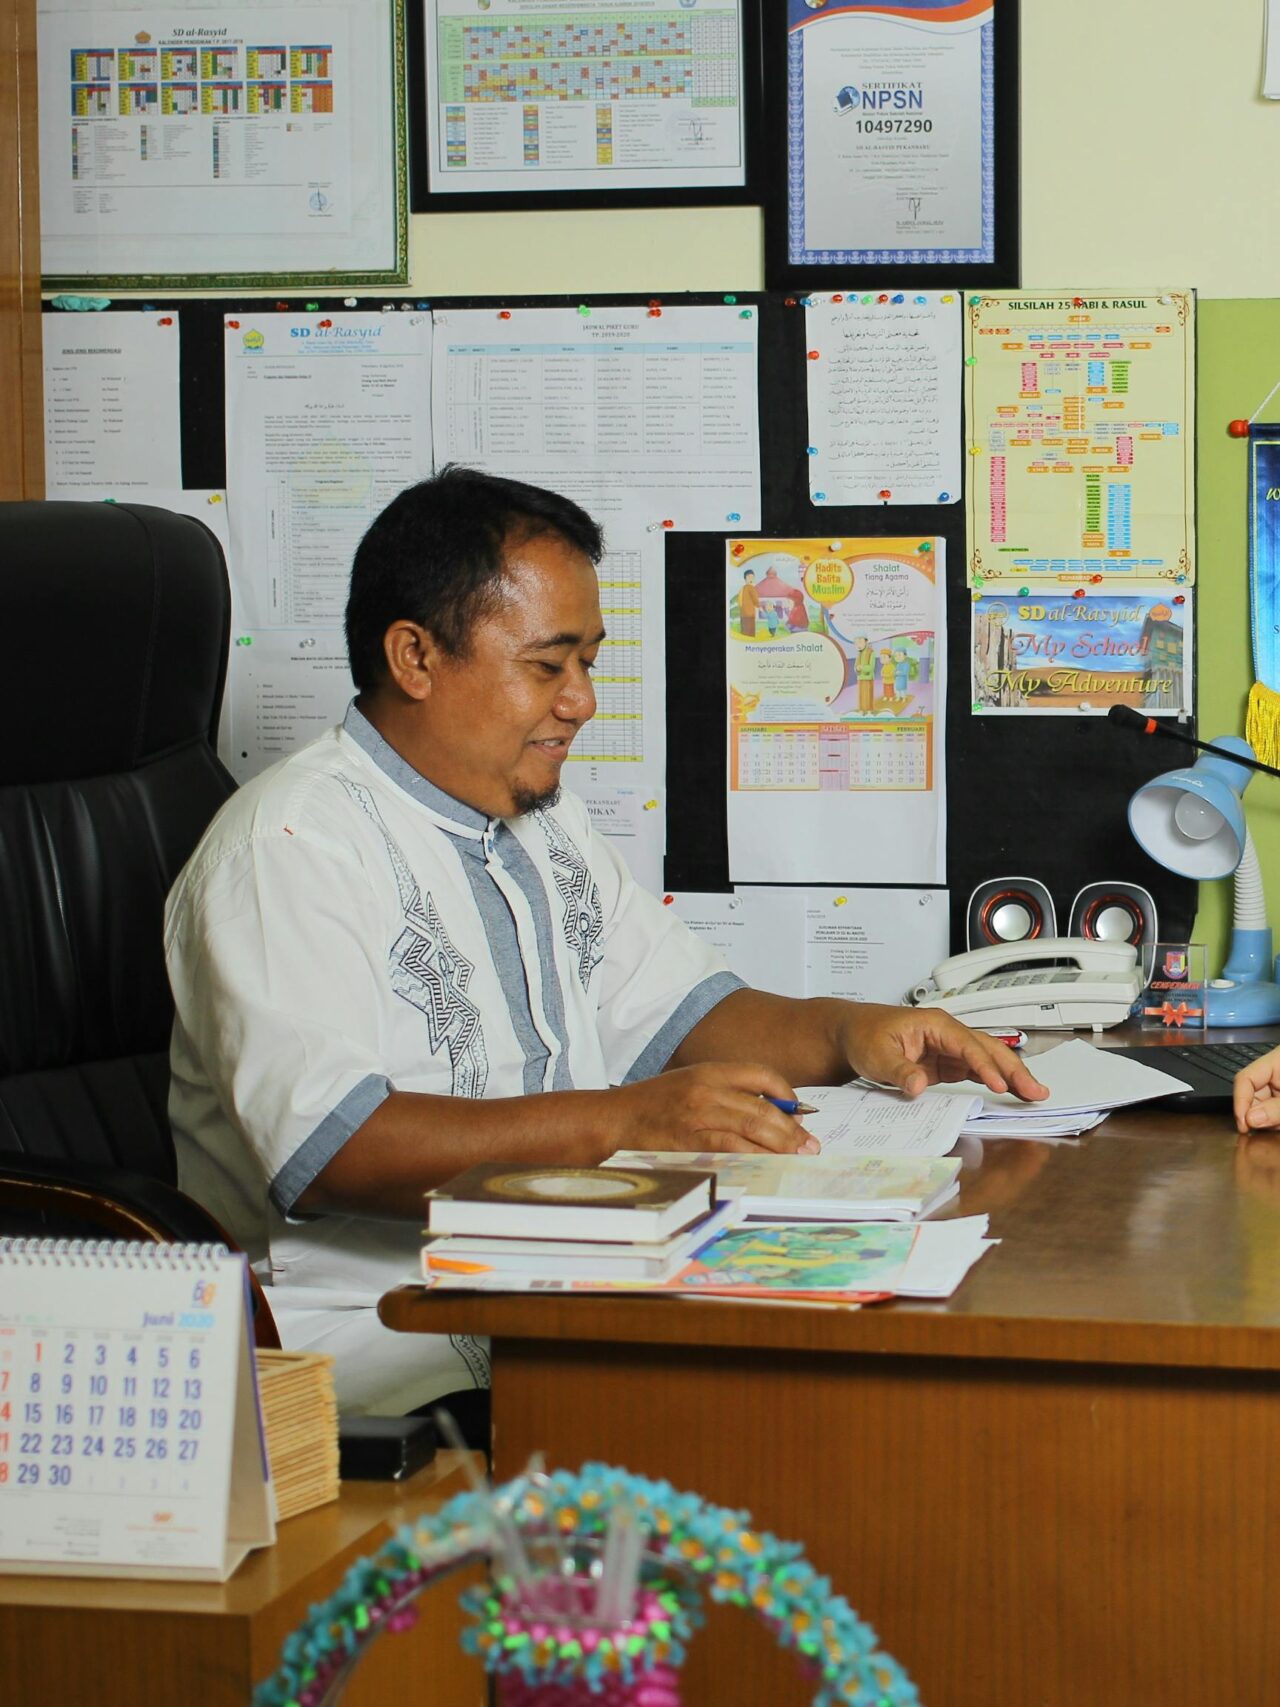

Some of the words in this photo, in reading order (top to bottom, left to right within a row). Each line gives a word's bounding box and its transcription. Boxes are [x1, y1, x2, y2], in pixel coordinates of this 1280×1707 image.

[862, 90, 923, 110] NPSN
[856, 120, 933, 134] 10497290
[1008, 300, 1054, 310] SILSILAH
[1058, 300, 1071, 310] 25
[1074, 300, 1099, 310] NABI
[1101, 300, 1110, 310] &
[1112, 299, 1148, 310] RASUL
[290, 328, 311, 338] SD
[314, 324, 384, 340] al-Rasyid
[815, 562, 842, 572] Hadits
[872, 564, 900, 572] Shalat
[816, 574, 842, 584] Balita
[864, 573, 884, 581] Tiang
[885, 573, 910, 582] Agama
[812, 584, 845, 594] Muslim
[1017, 604, 1046, 622] SD
[1048, 603, 1144, 627] al-Rasyid
[745, 645, 796, 654] Menyegerakan
[796, 644, 824, 652] Shalat
[1009, 631, 1066, 663] My
[1070, 630, 1152, 658] School
[984, 668, 1041, 699] My
[1046, 668, 1173, 694] Adventure
[142, 1312, 174, 1328] Juni
[34, 1342, 42, 1362] 1
[64, 1343, 76, 1366] 2
[94, 1344, 107, 1366] 3
[126, 1346, 138, 1367] 4
[158, 1347, 170, 1369] 5
[188, 1348, 200, 1370] 6
[30, 1372, 42, 1394] 8
[61, 1373, 73, 1395] 9
[89, 1374, 108, 1396] 10
[123, 1376, 137, 1397] 11
[152, 1377, 171, 1399] 12
[184, 1378, 202, 1401] 13
[24, 1402, 43, 1425] 15
[55, 1403, 74, 1426] 16
[88, 1405, 105, 1426] 17
[118, 1406, 137, 1428] 18
[150, 1408, 169, 1430] 19
[179, 1409, 202, 1431] 20
[20, 1432, 42, 1454] 22
[51, 1433, 74, 1456] 23
[82, 1435, 105, 1457] 24
[114, 1436, 137, 1458] 25
[145, 1437, 169, 1460] 26
[178, 1438, 199, 1461] 27
[16, 1462, 40, 1485] 29
[48, 1464, 73, 1486] 30
